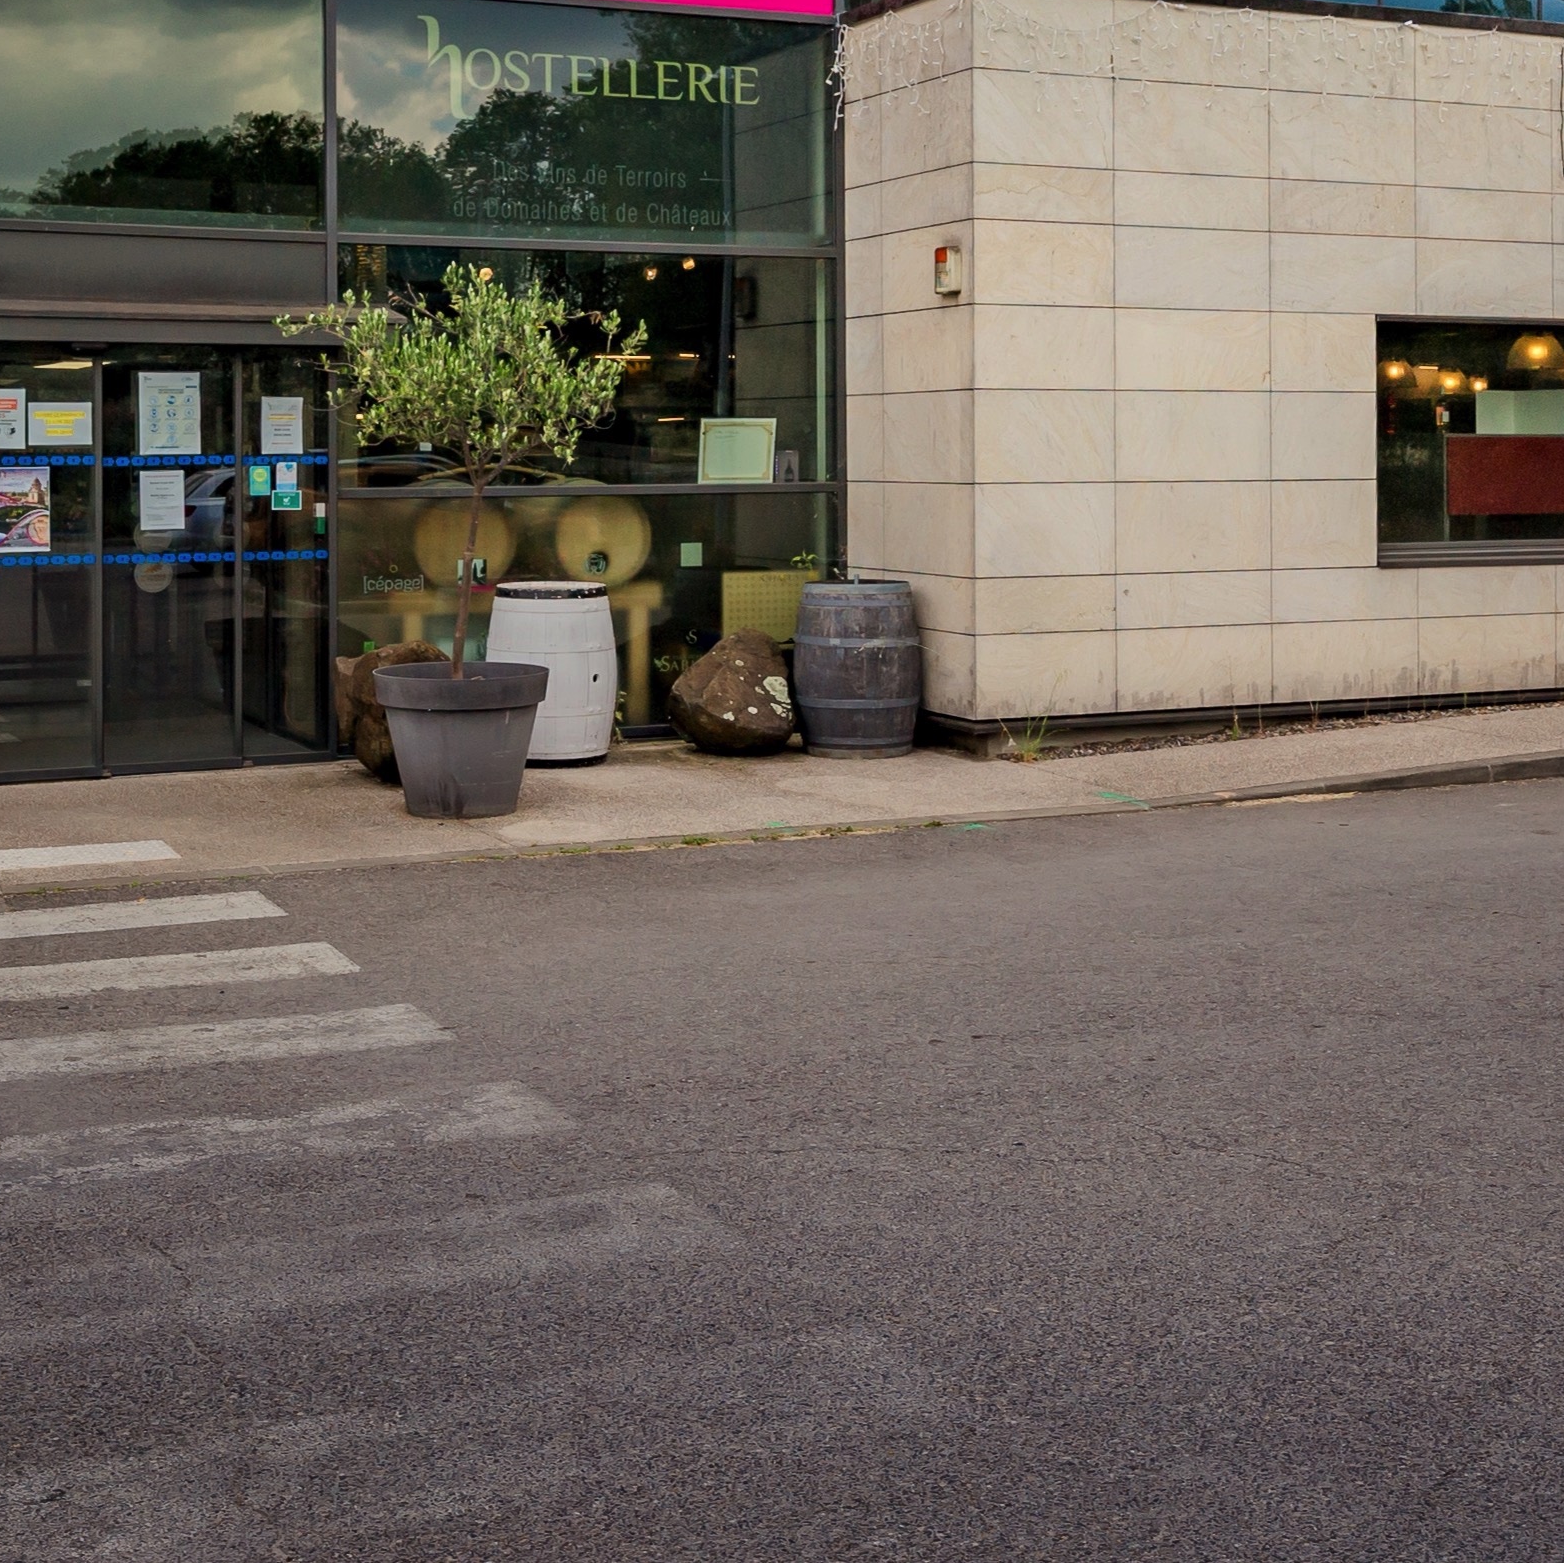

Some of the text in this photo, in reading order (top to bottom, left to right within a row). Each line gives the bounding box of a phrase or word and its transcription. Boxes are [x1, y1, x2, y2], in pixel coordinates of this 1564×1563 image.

[586, 164, 608, 186] de
[614, 165, 687, 189] Terroirs
[453, 198, 477, 218] de
[590, 203, 608, 223] et
[616, 202, 638, 223] de
[646, 203, 732, 227] Châteaux
